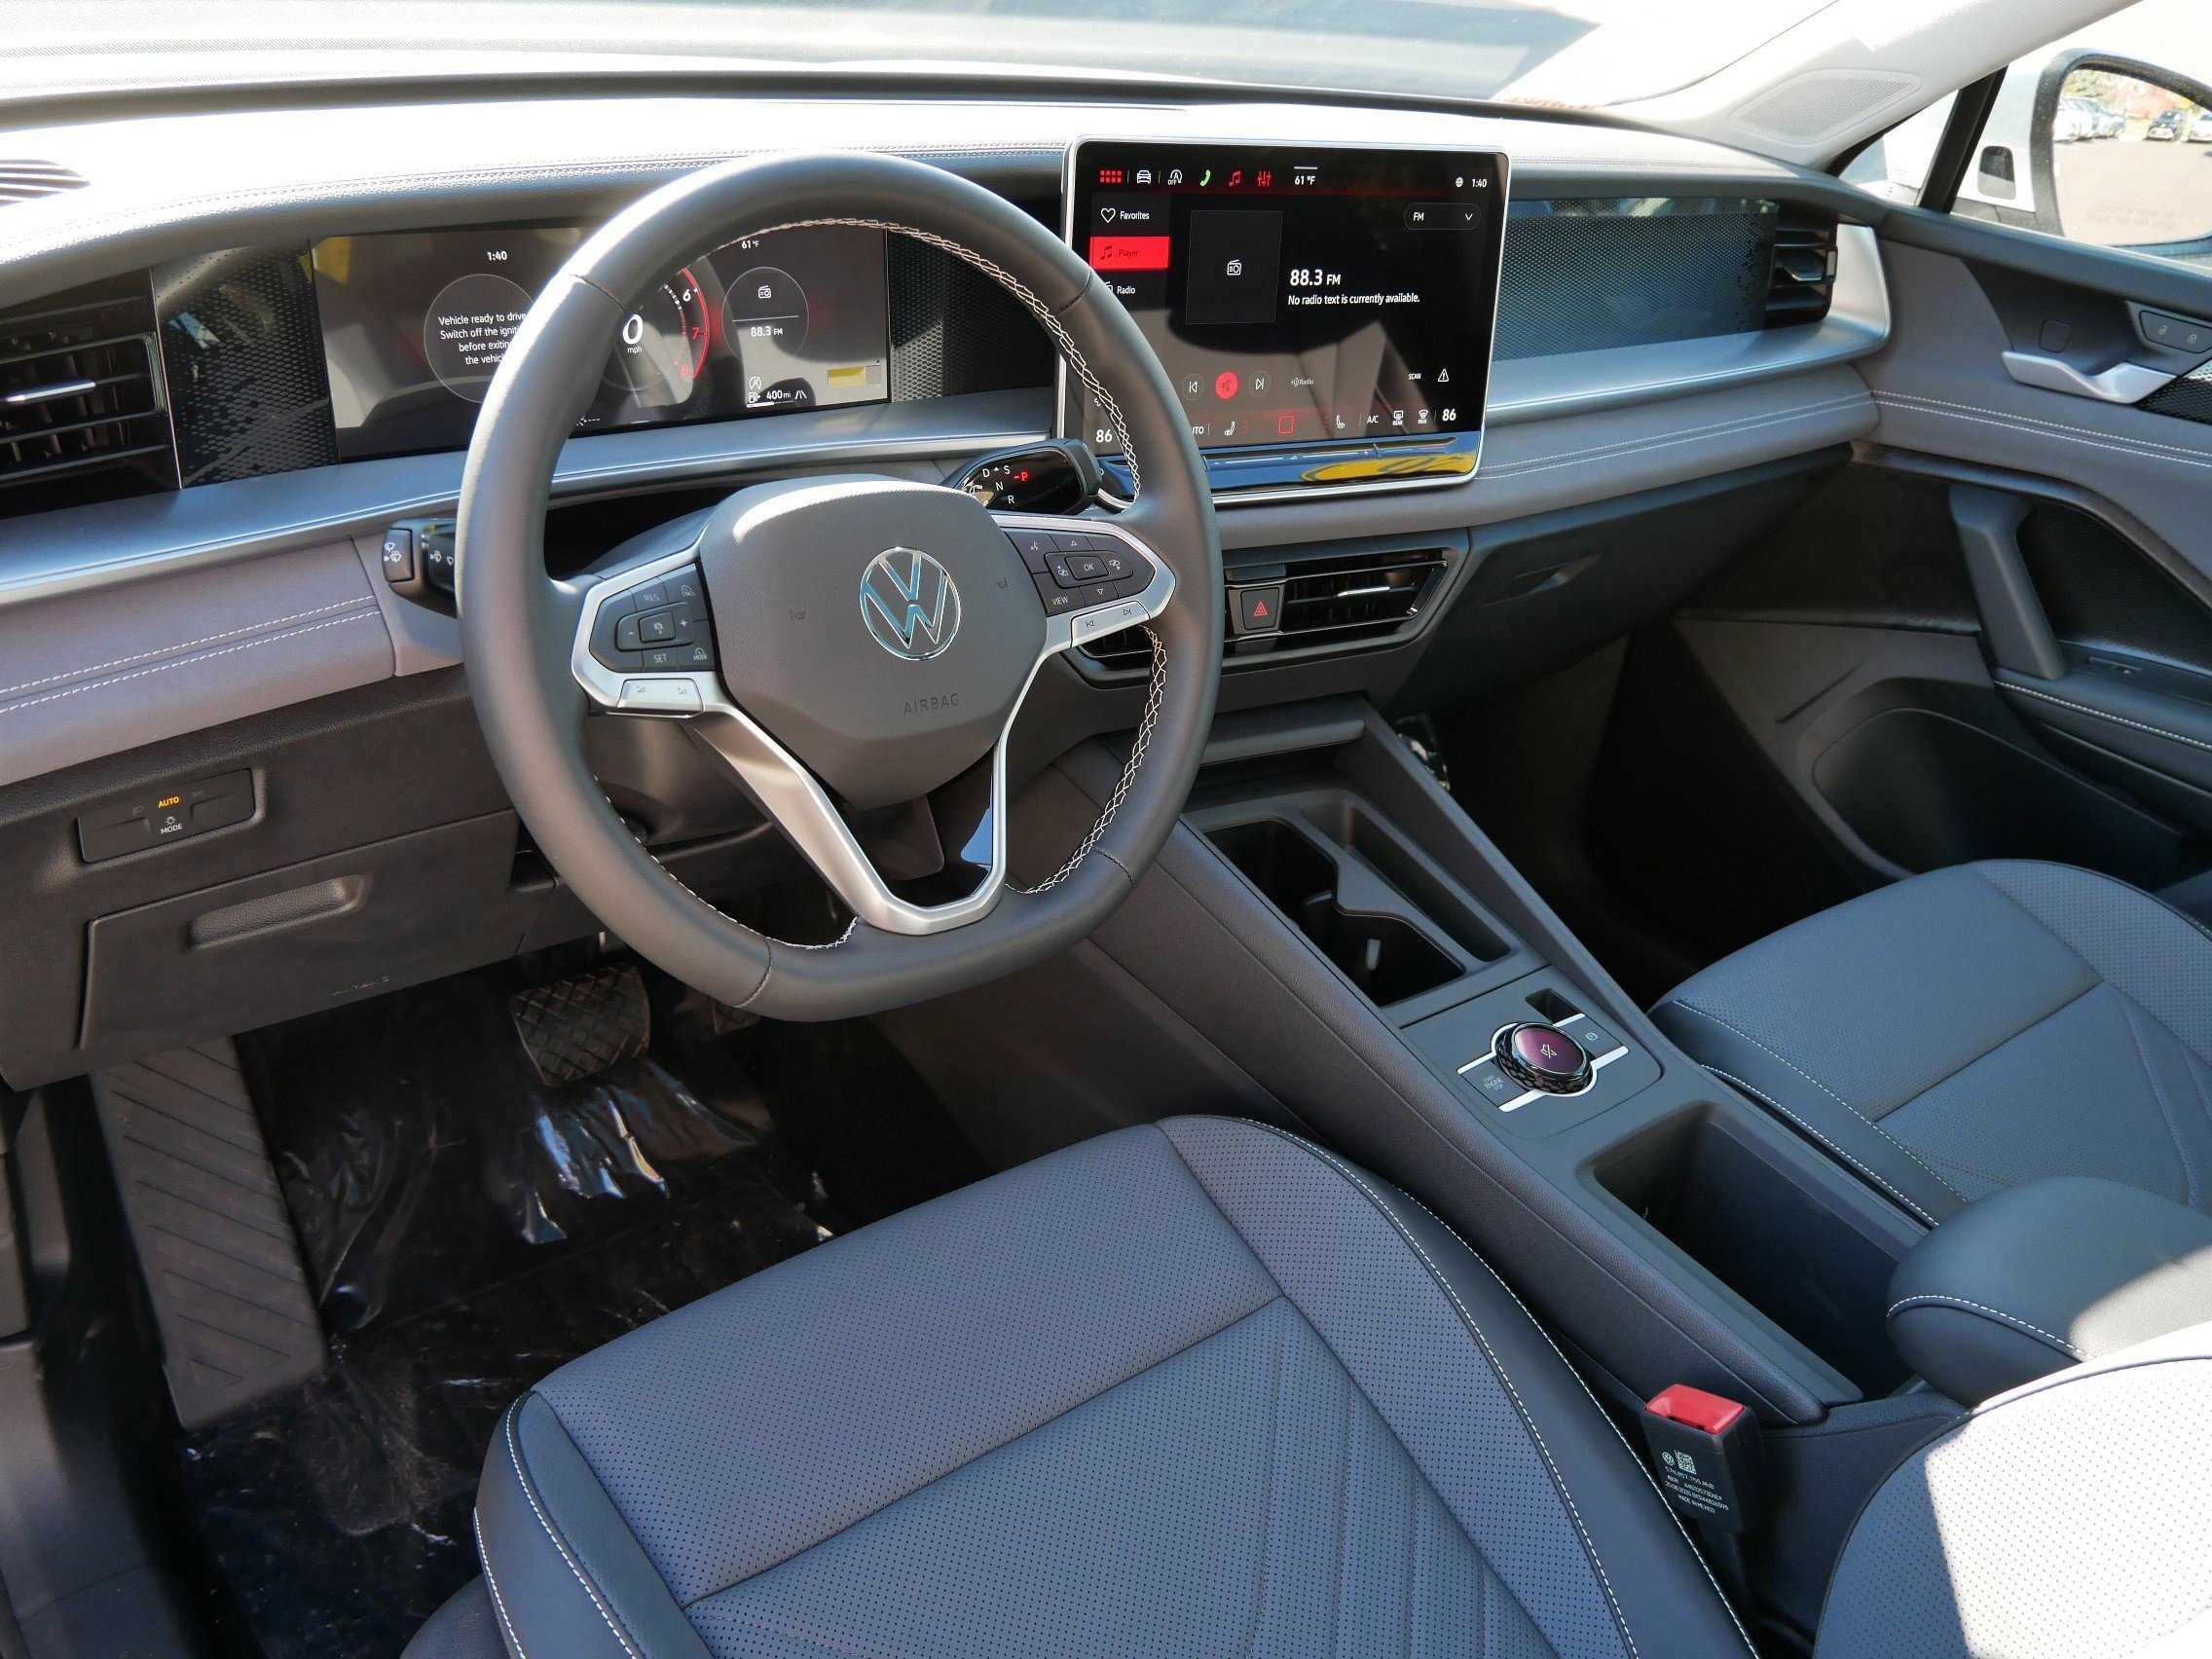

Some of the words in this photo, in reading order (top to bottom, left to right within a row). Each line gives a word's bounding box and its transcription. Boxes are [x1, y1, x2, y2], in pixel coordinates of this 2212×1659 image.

[1294, 175, 1305, 185] 61
[1471, 178, 1488, 188] 1:40
[1120, 210, 1150, 220] Favorites
[1413, 212, 1424, 221] FM
[741, 240, 751, 249] 61
[487, 250, 507, 261] 1:40
[1119, 248, 1139, 258] Player
[1290, 269, 1323, 286] 88.3
[1326, 274, 1342, 285] FM
[1117, 285, 1136, 294] Radio
[682, 289, 691, 302] 6
[1288, 295, 1301, 306] No
[1302, 294, 1322, 305] radio
[1324, 295, 1340, 305] text
[1341, 294, 1348, 304] is
[1349, 293, 1384, 306] currently
[1385, 292, 1420, 303] available.
[438, 314, 469, 326] Vehicle
[471, 313, 494, 324] ready
[497, 313, 505, 322] to
[440, 327, 468, 340] Switch
[470, 327, 482, 338] off
[485, 326, 498, 336] the
[623, 313, 644, 345] 0
[692, 327, 701, 340] 7
[751, 325, 772, 337] 88.3
[773, 327, 784, 336] FM
[459, 341, 486, 351] before
[488, 340, 510, 350] exitin
[627, 346, 643, 354] mph
[465, 354, 479, 365] the
[766, 390, 783, 400] 400
[1366, 415, 1379, 424] A/C
[1442, 408, 1456, 422] 86
[1095, 428, 1113, 443] 86
[982, 468, 990, 478] D
[1004, 464, 1011, 475] S
[1020, 471, 1028, 482] P
[995, 481, 1004, 492] N
[1008, 495, 1014, 504] R
[1084, 563, 1095, 571] OK
[644, 593, 660, 602] RES
[1051, 596, 1069, 606] VIEW
[653, 653, 668, 663] SET
[903, 692, 960, 717] AIRBAG
[158, 796, 180, 808] AUTO
[161, 823, 183, 835] MODE
